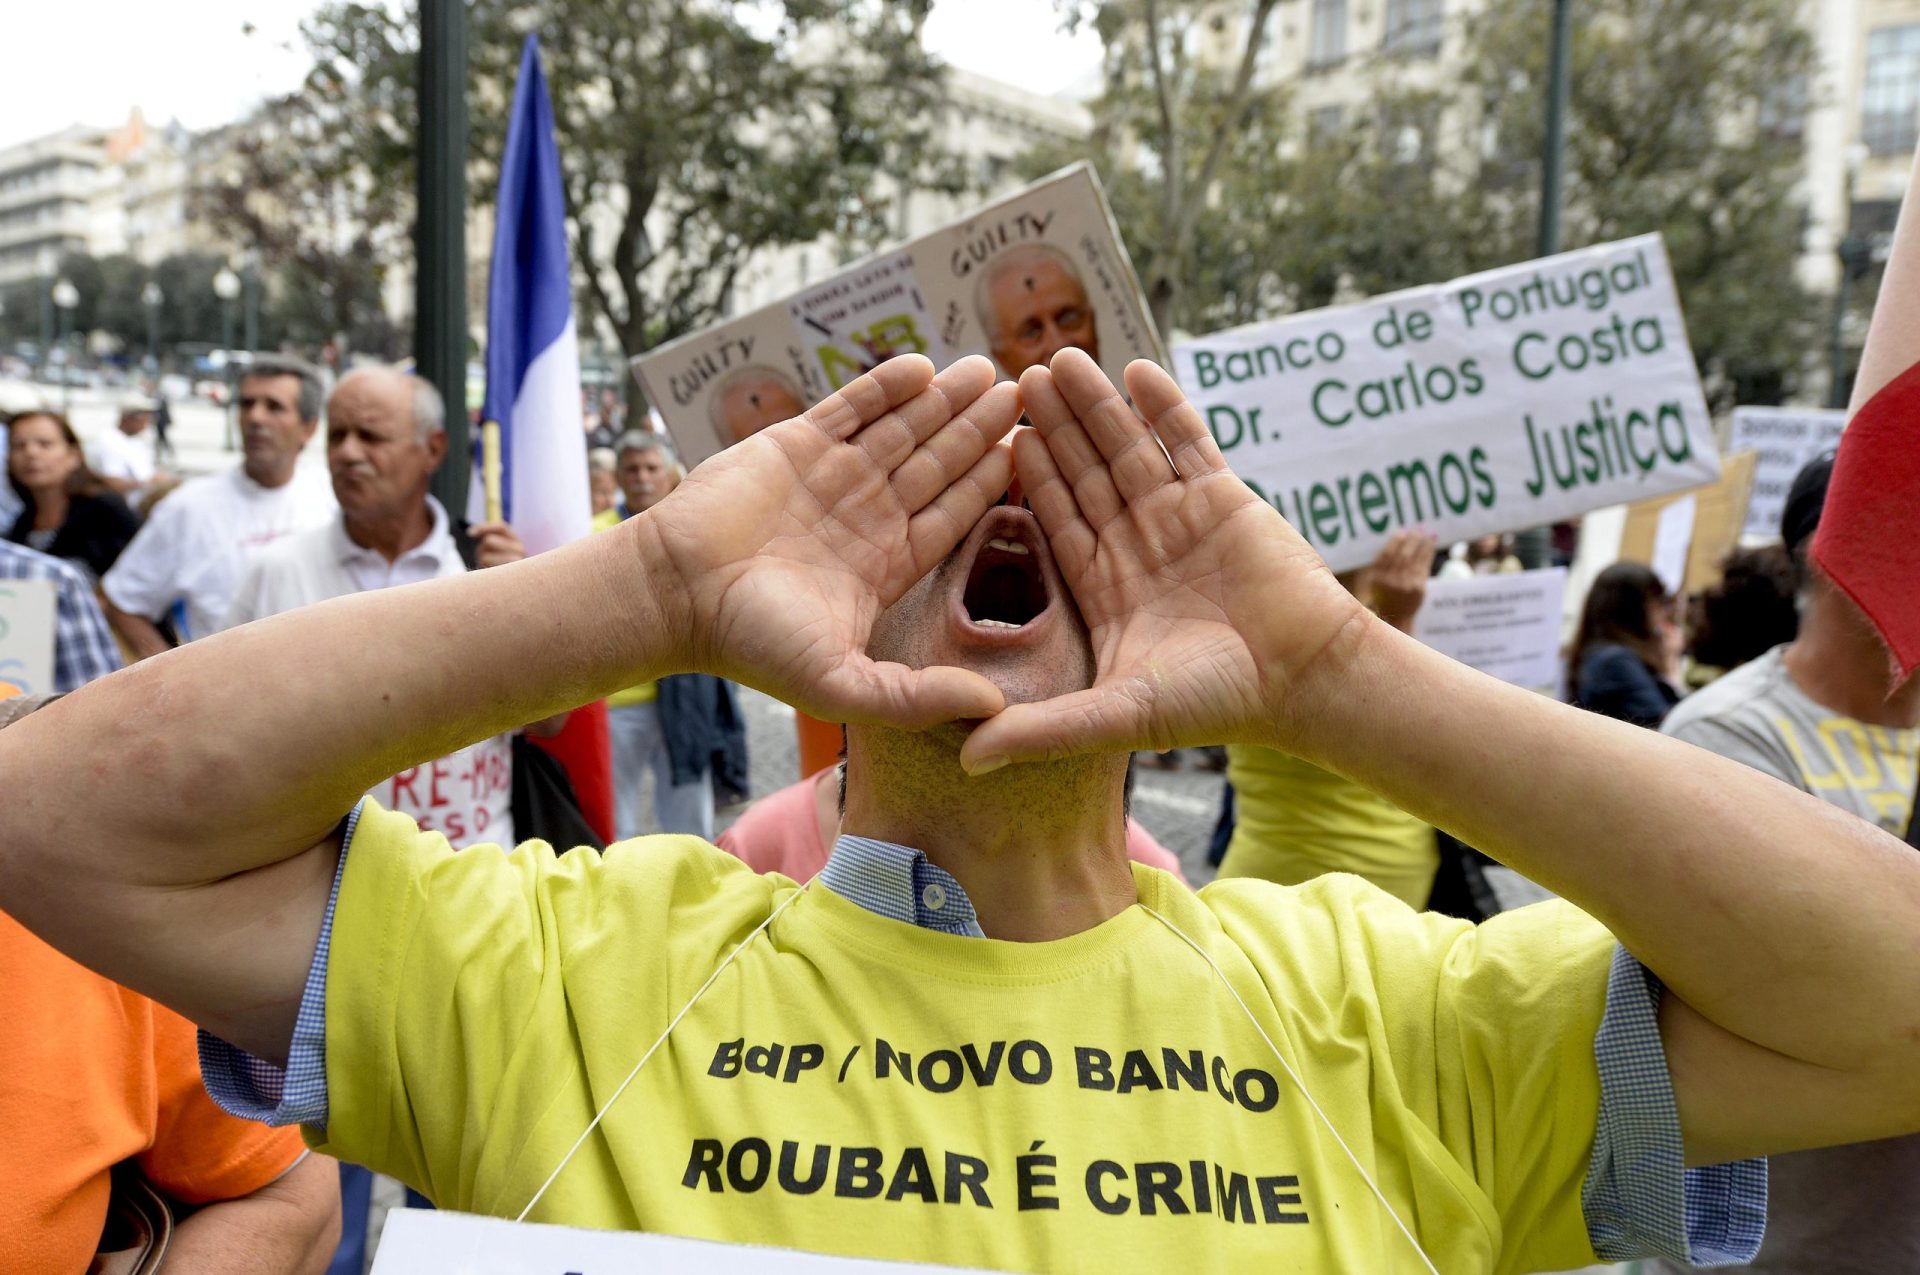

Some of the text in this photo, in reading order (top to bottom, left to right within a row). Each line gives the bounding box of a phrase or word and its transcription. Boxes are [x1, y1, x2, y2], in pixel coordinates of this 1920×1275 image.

[950, 209, 1055, 279] GUILTY
[1193, 250, 1651, 389] Banco de Portugal
[669, 336, 755, 407] GUILTY
[1205, 312, 1666, 451] Dr. Carlos Costa
[1242, 396, 1692, 546] ueremos Justiça
[707, 1037, 825, 1083] BdP
[875, 1038, 1053, 1094] NOVO
[1074, 1046, 1281, 1113] BANCO
[681, 1137, 1311, 1225] ROUBAR É CRIME
